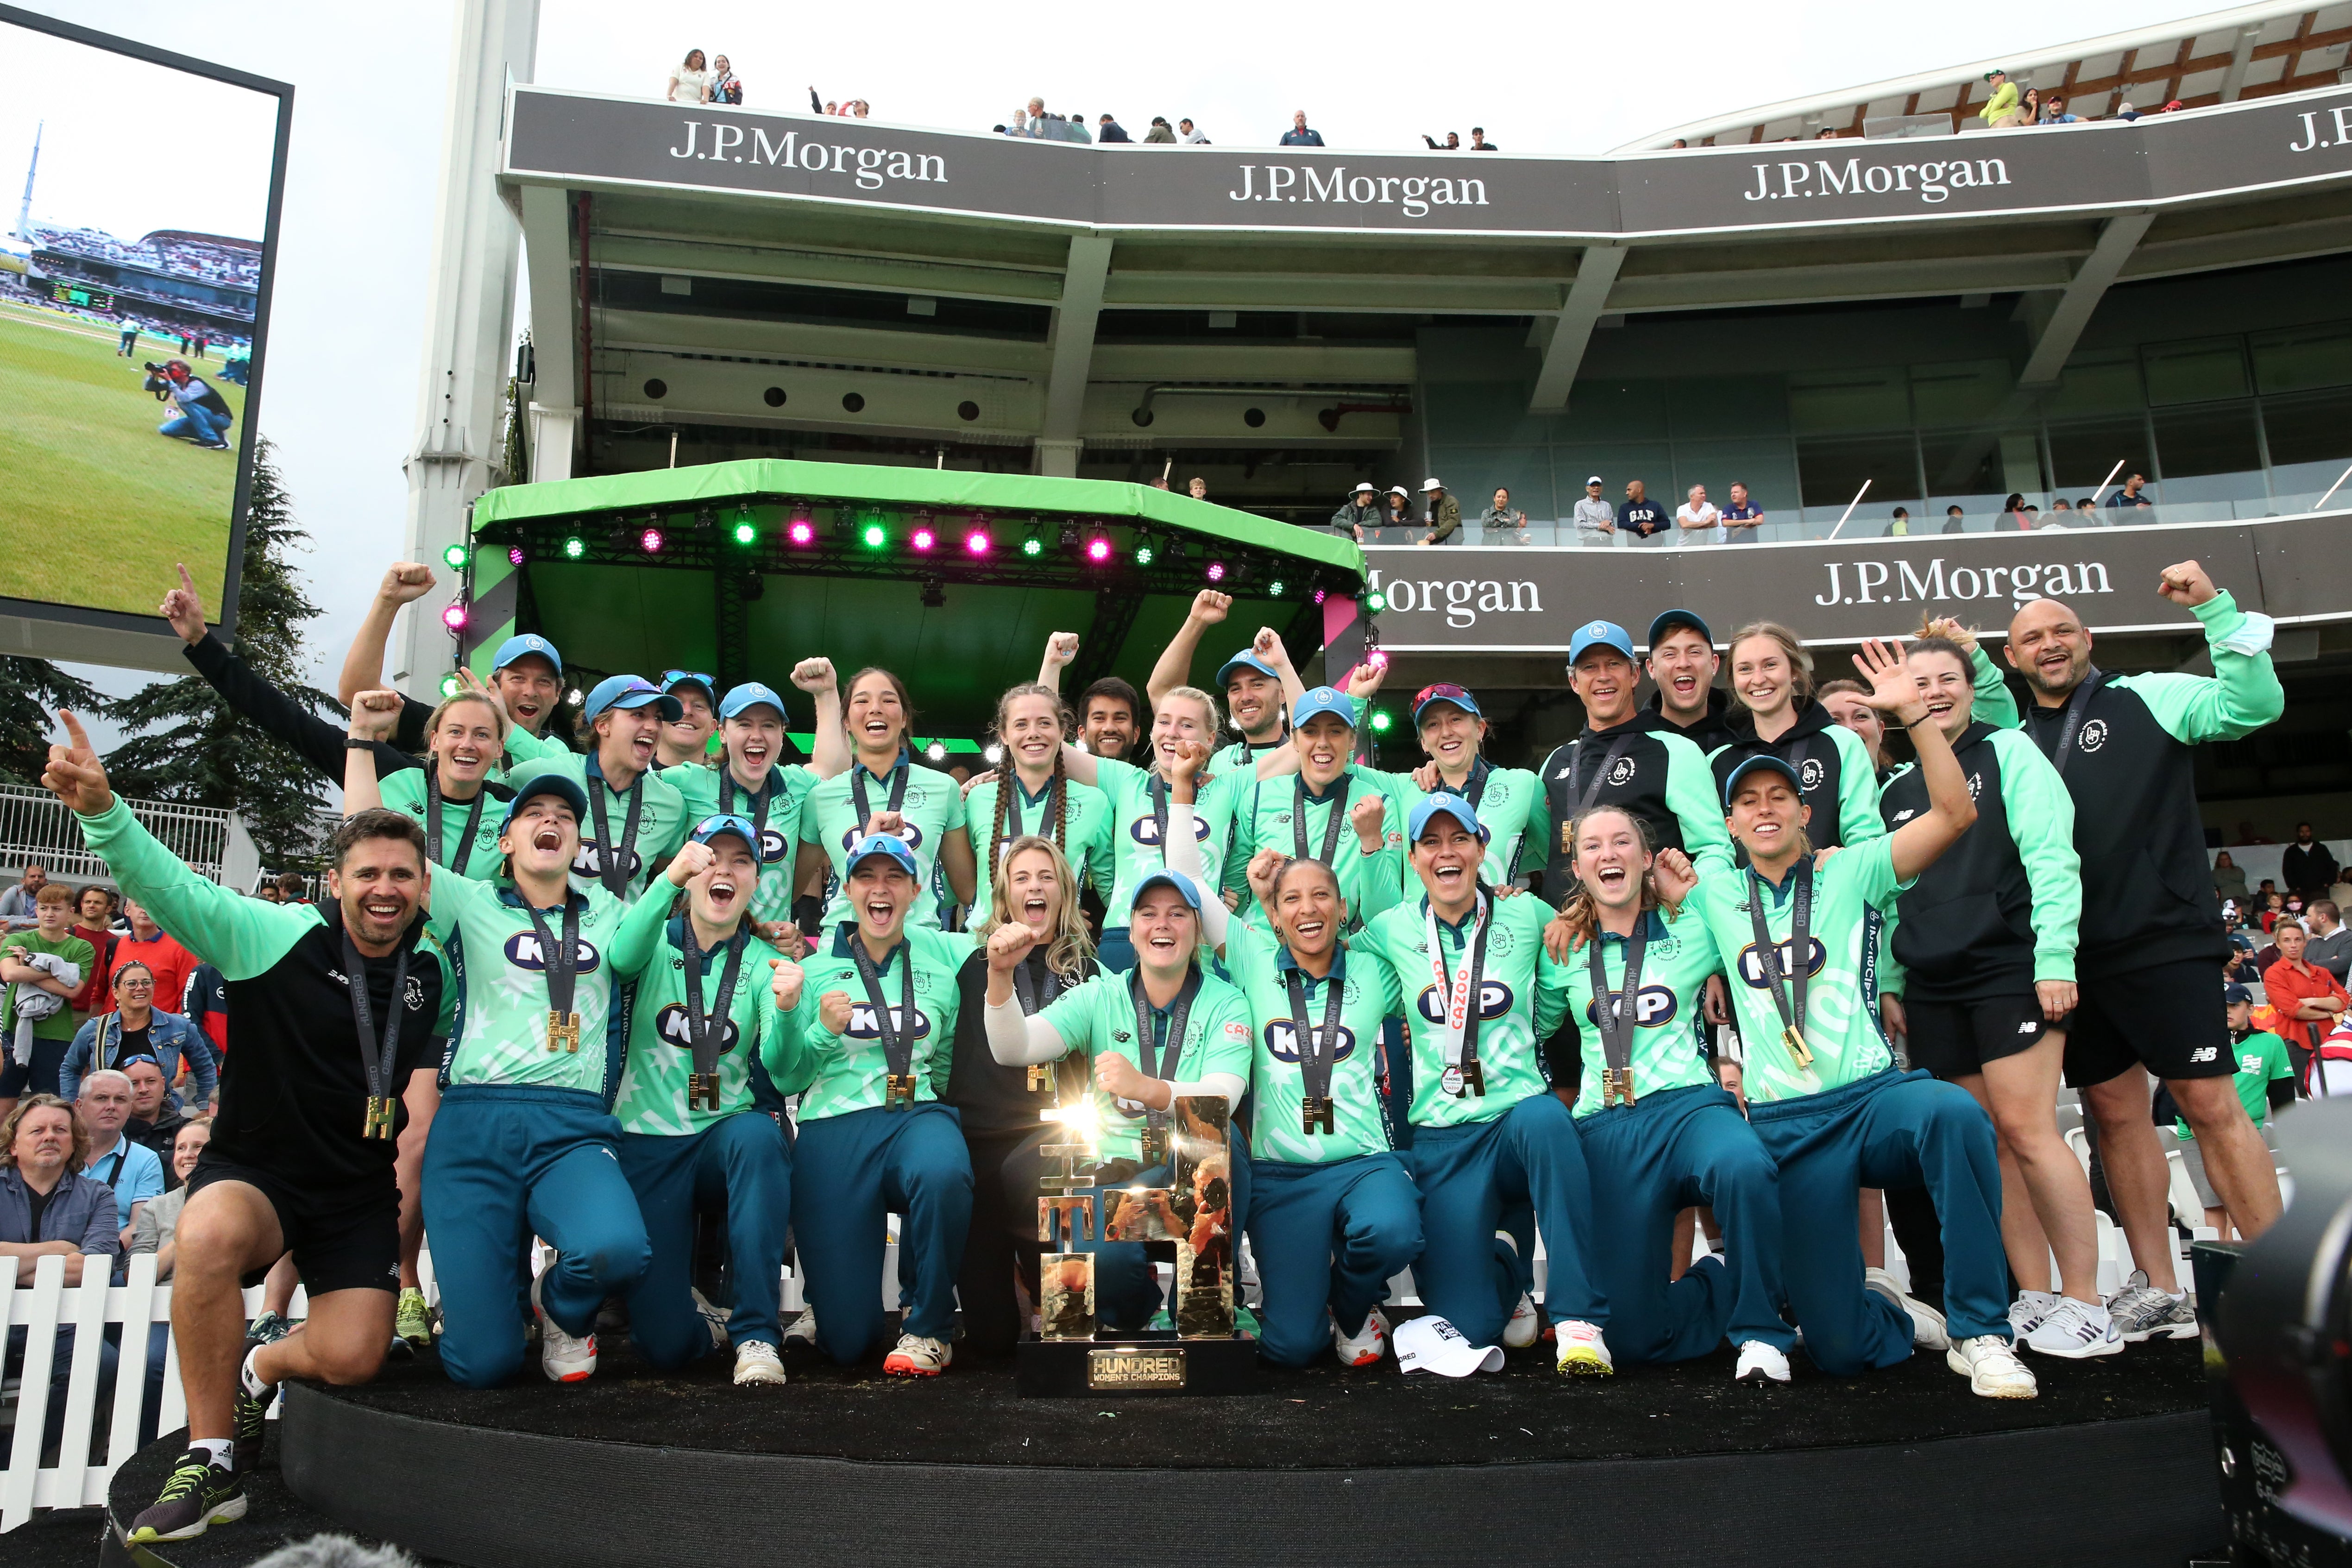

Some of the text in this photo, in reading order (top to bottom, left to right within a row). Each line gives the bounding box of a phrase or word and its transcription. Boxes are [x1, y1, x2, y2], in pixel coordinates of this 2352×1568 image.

[670, 121, 948, 190] J.P.Morgan
[1230, 165, 1490, 218] J.P.Morgan
[1744, 157, 2012, 204] J.P.Morgan
[1629, 510, 1654, 523] GAP
[1815, 558, 2114, 611] J.P.Morgan
[2061, 710, 2079, 749] HUNDRED
[2082, 719, 2107, 736] INVINCIBLES
[2084, 743, 2103, 752] LONDON
[1592, 755, 1616, 790] HUNDRED
[1065, 797, 1082, 817] VINCIBLES
[1296, 804, 1305, 843] HUNDRED
[477, 844, 493, 852] LONDON
[597, 824, 610, 865] HUNDRED
[621, 826, 634, 867] HUNDRED
[762, 836, 783, 857] P
[1325, 812, 1340, 851] HUNDRED
[1796, 881, 1808, 926] HUNDRED
[541, 930, 559, 973] HUNDRED
[564, 926, 574, 965] HUNDRED
[855, 942, 874, 979] HUNDRED
[1347, 975, 1361, 994] CIBLES
[1623, 968, 1637, 1016] HUNDRED
[1763, 952, 1784, 1001] HUNDRED
[352, 974, 370, 1027] HUNDRED
[690, 991, 703, 1039] HUNDRED
[714, 982, 730, 1027] HUNDRED
[1452, 970, 1469, 1030] CAZOO
[1596, 985, 1613, 1033] HUNDRED
[877, 1006, 894, 1049] HUNDRED
[1138, 1000, 1150, 1045] HUNDRED
[1170, 1003, 1187, 1048] HUNDRED
[1298, 1020, 1313, 1067] HUNDRED
[1324, 1000, 1338, 1045] HUNDRED
[383, 1023, 396, 1075] HUNDRED
[1094, 1357, 1181, 1374] HUNDRED
[1094, 1373, 1181, 1382] WOMEN'S CHAMPIONS
